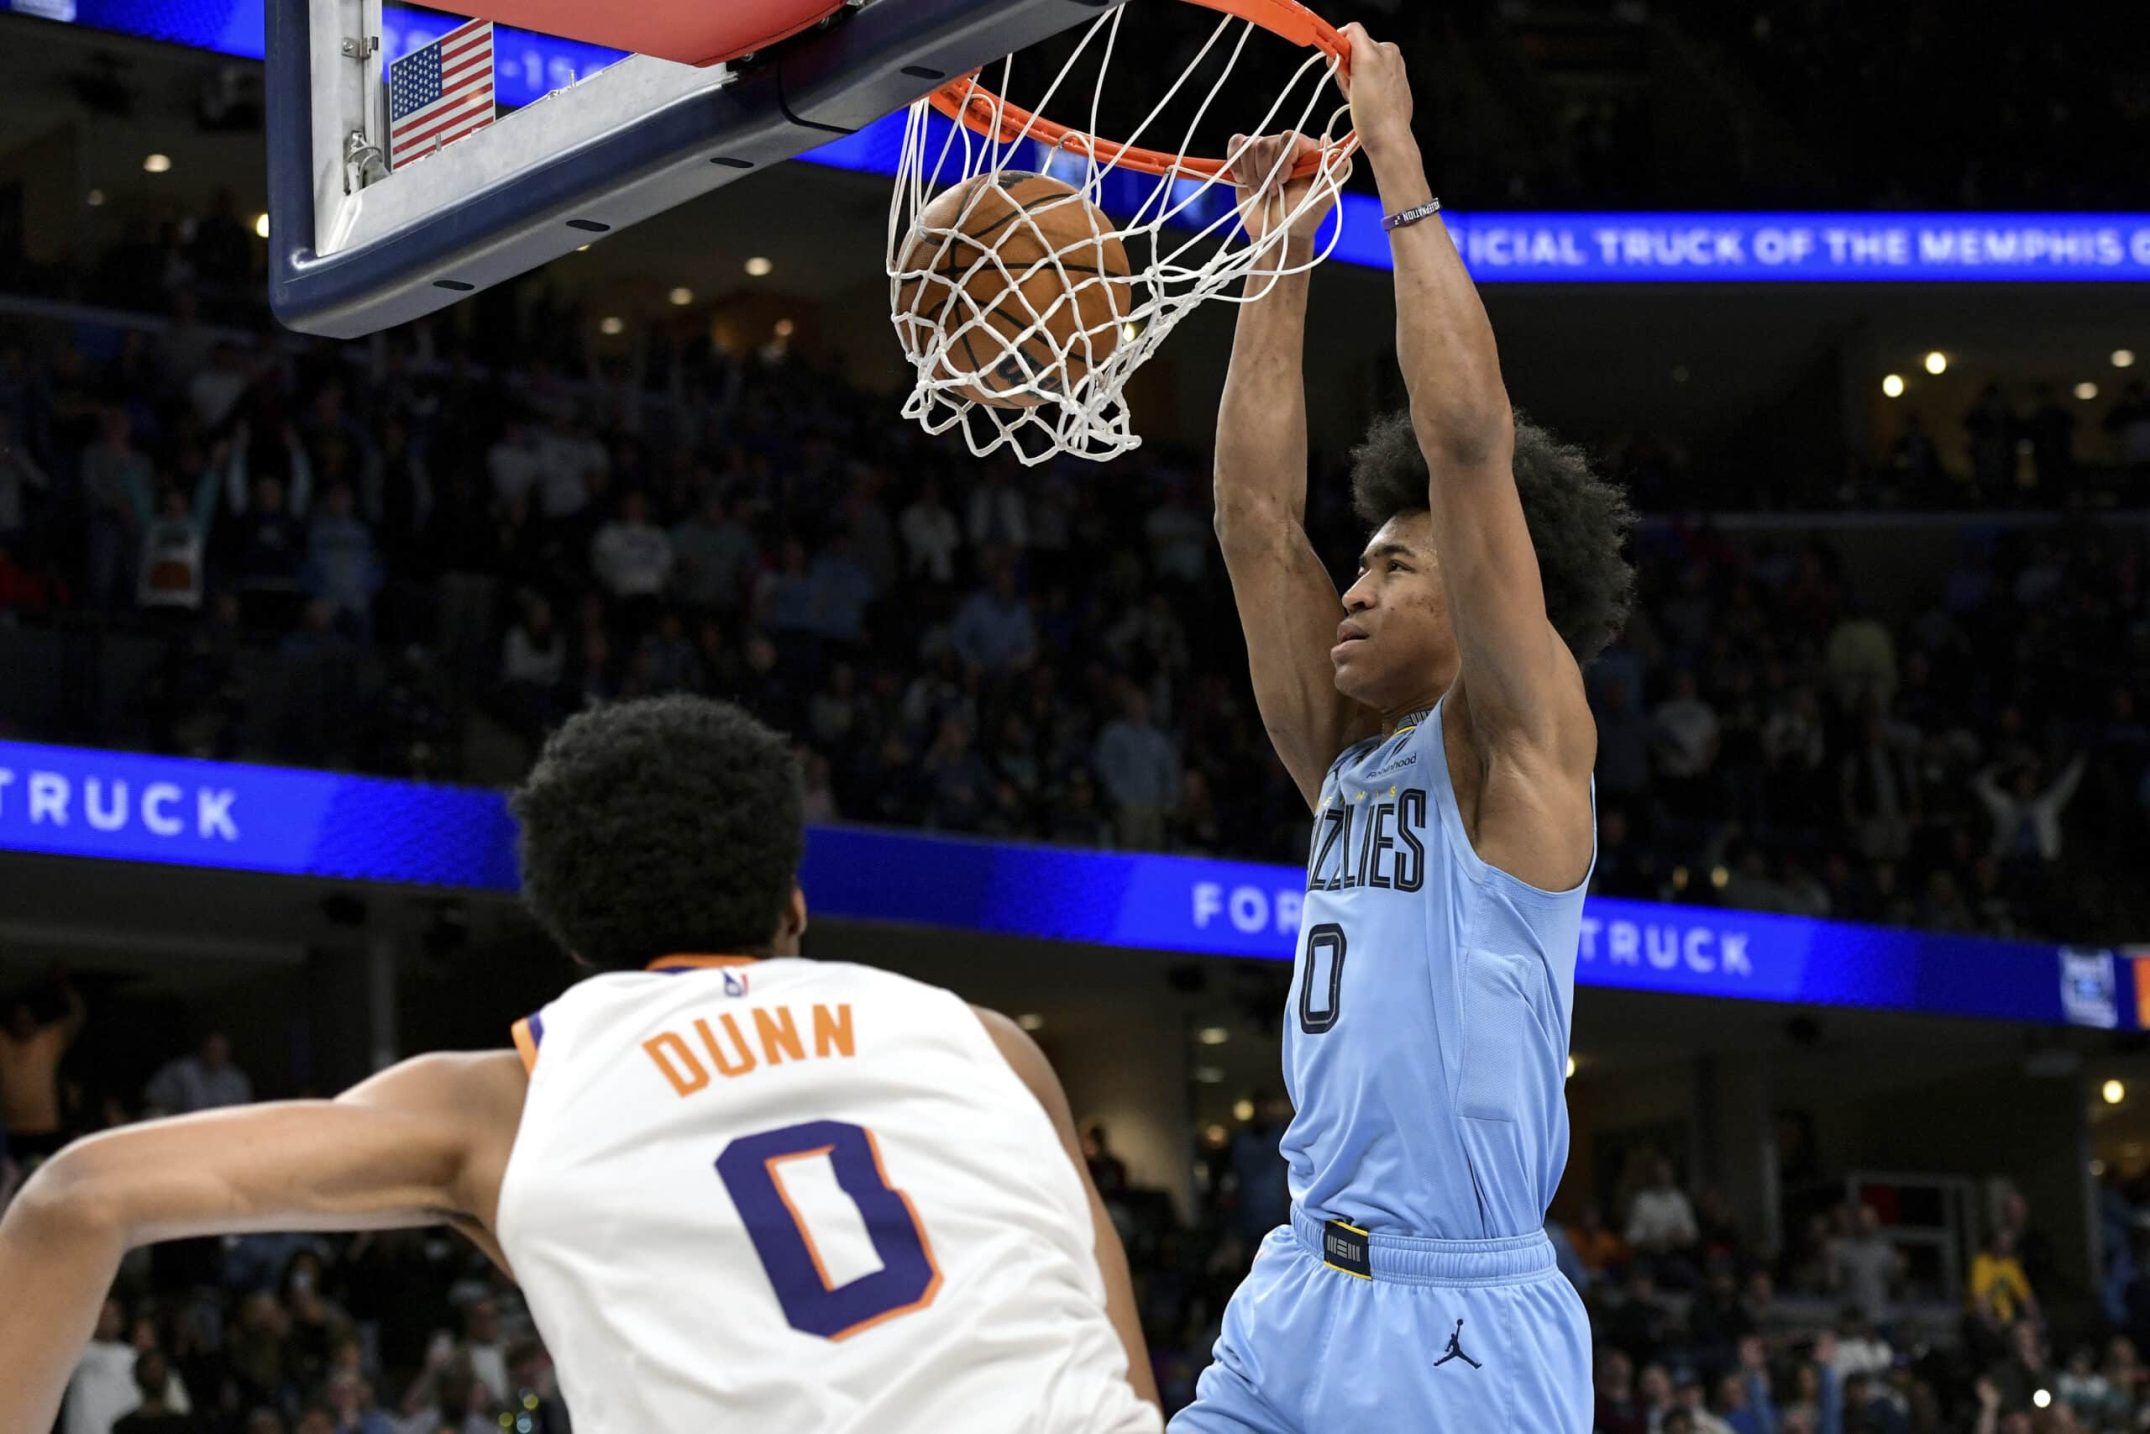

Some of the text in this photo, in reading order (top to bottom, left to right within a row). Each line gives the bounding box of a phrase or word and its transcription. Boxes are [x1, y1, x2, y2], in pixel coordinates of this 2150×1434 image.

[1592, 228, 1747, 266] TRUCK
[1753, 228, 1815, 266] OF
[1822, 228, 1910, 266] THE
[1918, 228, 2126, 266] MEMPHIS
[1299, 922, 1347, 1035] 0
[1579, 916, 1752, 977] TRUCK
[641, 1003, 856, 1098] DUNN
[714, 1119, 945, 1343] 0
